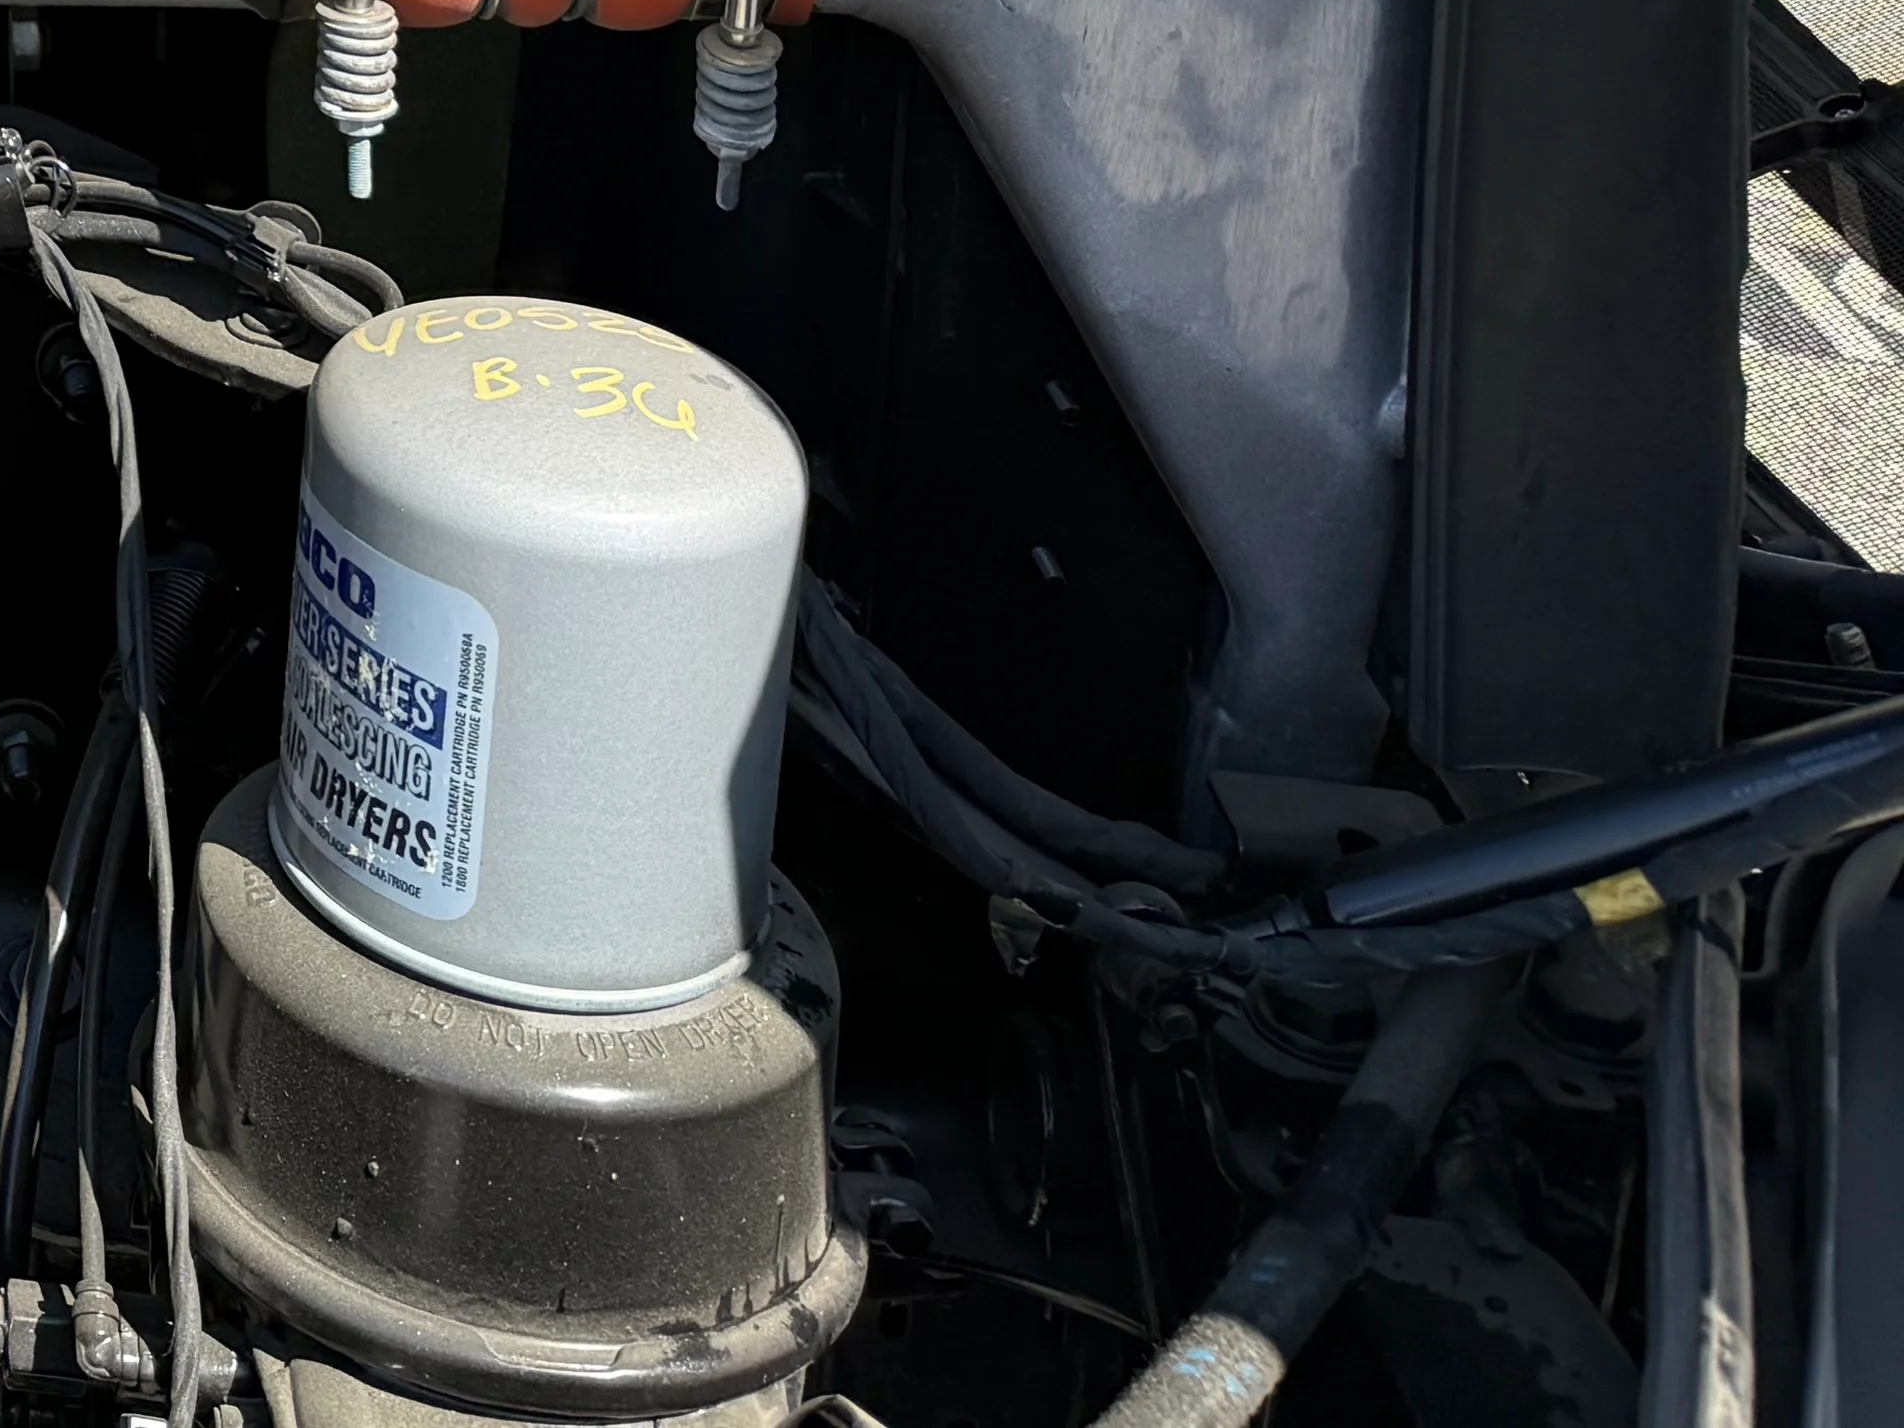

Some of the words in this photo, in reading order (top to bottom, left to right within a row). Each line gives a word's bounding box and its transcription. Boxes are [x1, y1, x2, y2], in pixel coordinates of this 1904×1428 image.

[326, 622, 436, 734] SERIES
[456, 694, 470, 709] PN
[470, 697, 484, 713] PN
[451, 710, 467, 775] CARTRIDGE
[465, 714, 482, 780] CARTRIDGE
[310, 749, 438, 868] DRYERS
[442, 777, 461, 859] REPLACEMENT
[458, 782, 477, 863] REPLACEMENT
[441, 858, 454, 889] 1200
[406, 990, 455, 1030] DO
[478, 1014, 546, 1059] NOT
[574, 1028, 670, 1062] OPEN
